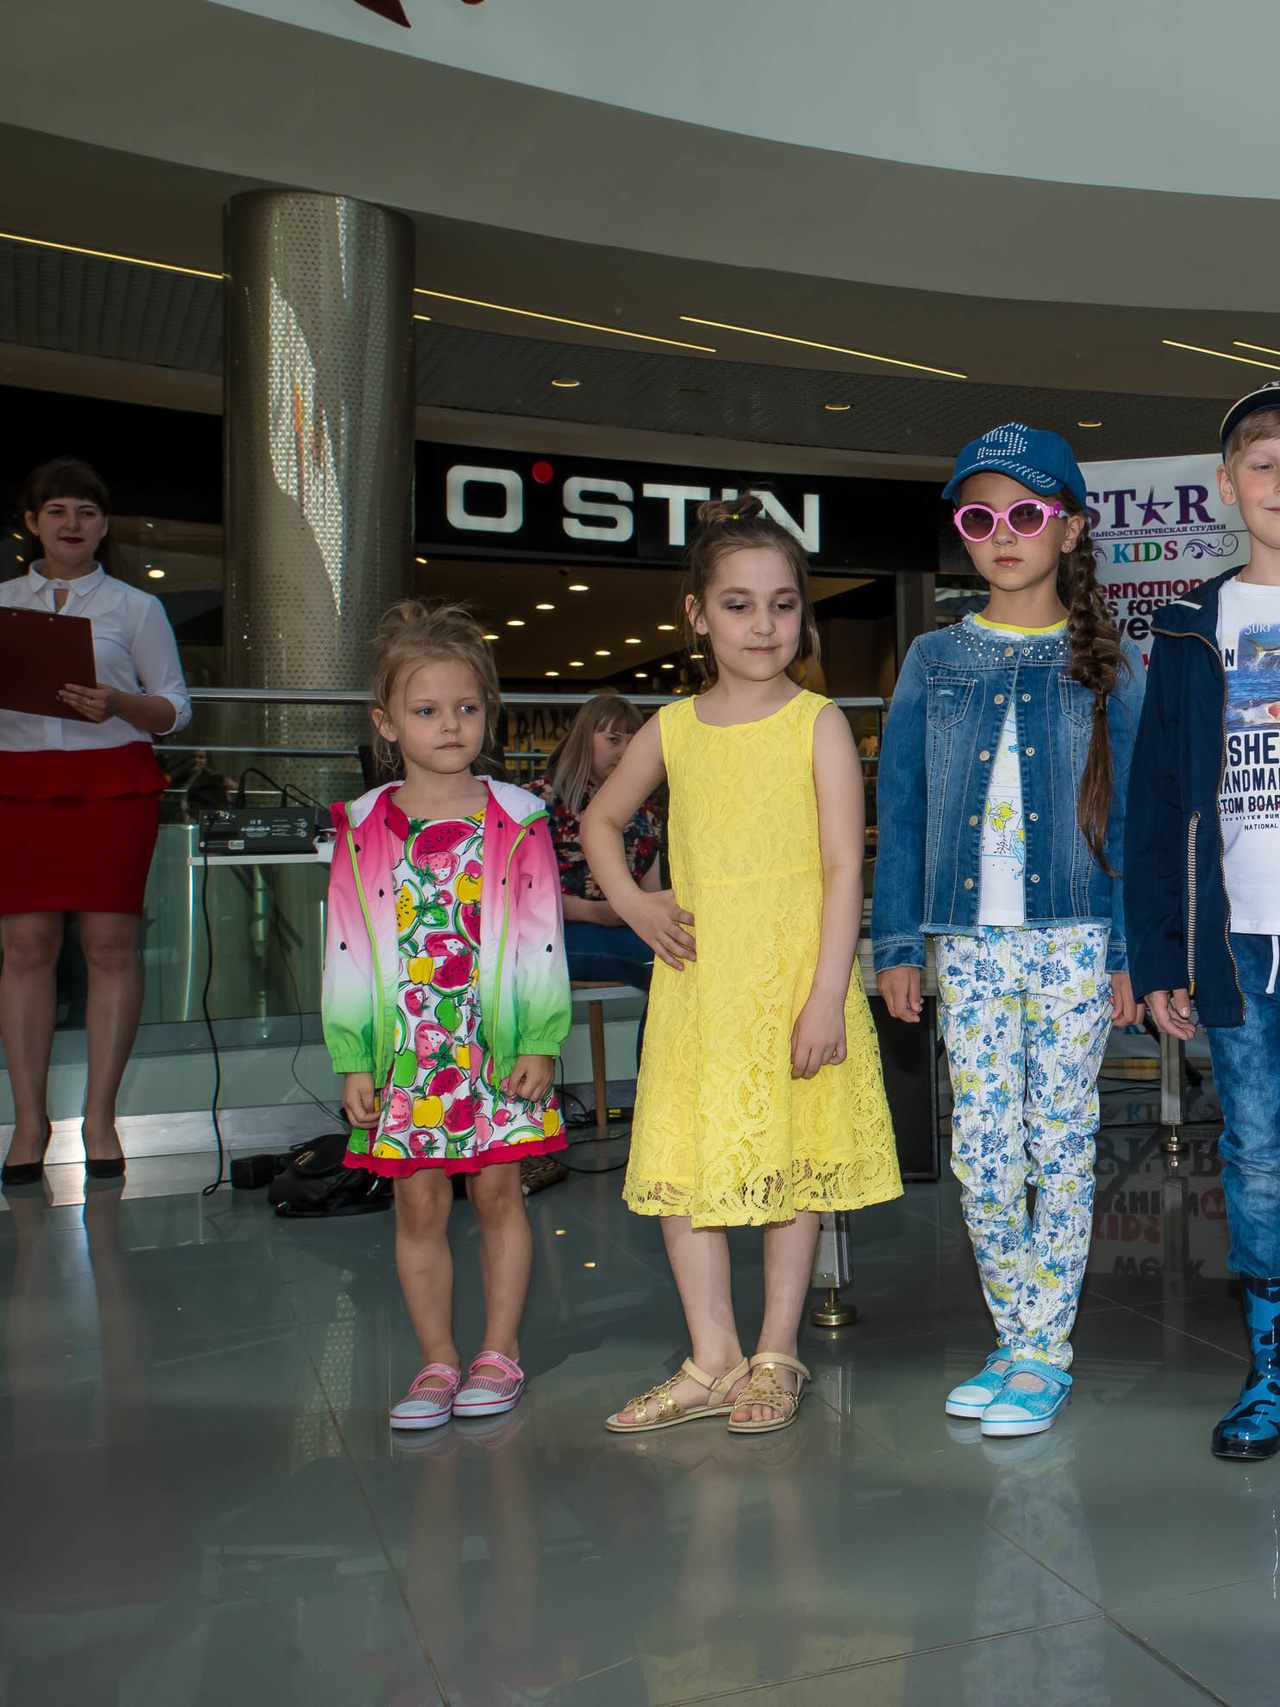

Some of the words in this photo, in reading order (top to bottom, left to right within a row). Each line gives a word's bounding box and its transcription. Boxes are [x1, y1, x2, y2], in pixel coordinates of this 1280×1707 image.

[446, 461, 820, 553] O'STN
[1090, 526, 1188, 538] ЛЬНО-ЭСТЕТИЧЕСКАЯ
[1189, 523, 1227, 533] СТУДИЯ
[1112, 540, 1179, 564] KIDS
[1244, 823, 1278, 831] NATIONAL
